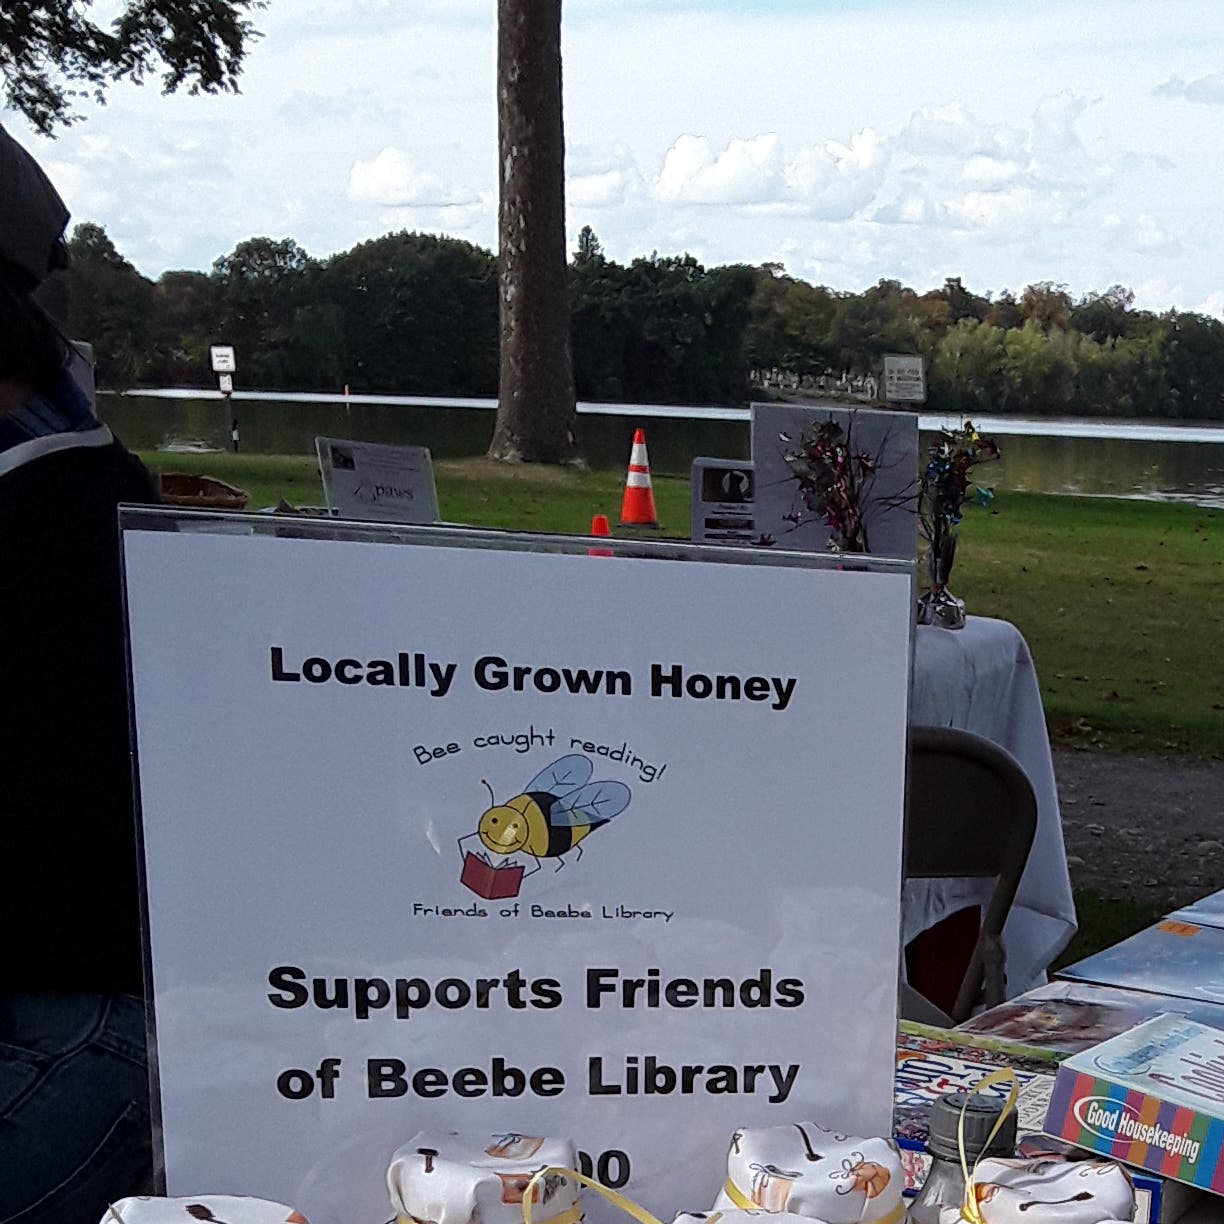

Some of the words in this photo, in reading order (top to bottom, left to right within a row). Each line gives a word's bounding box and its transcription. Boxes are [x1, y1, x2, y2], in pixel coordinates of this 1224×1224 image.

[270, 646, 457, 697] Locally
[474, 656, 633, 696] Grown
[650, 664, 797, 710] Honey
[413, 740, 462, 766] Bee
[473, 724, 556, 754] caught
[570, 737, 668, 784] reading!
[412, 902, 489, 919] Friends
[499, 901, 520, 918] of
[530, 902, 593, 919] Beebe
[602, 904, 675, 923] Library
[266, 965, 563, 1020] Supports
[586, 968, 805, 1010] Friends
[276, 1057, 340, 1100] of
[367, 1058, 565, 1099] Beebe
[588, 1056, 801, 1104] Library
[1086, 1100, 1119, 1131] Good
[1117, 1110, 1201, 1165] Housekeeping
